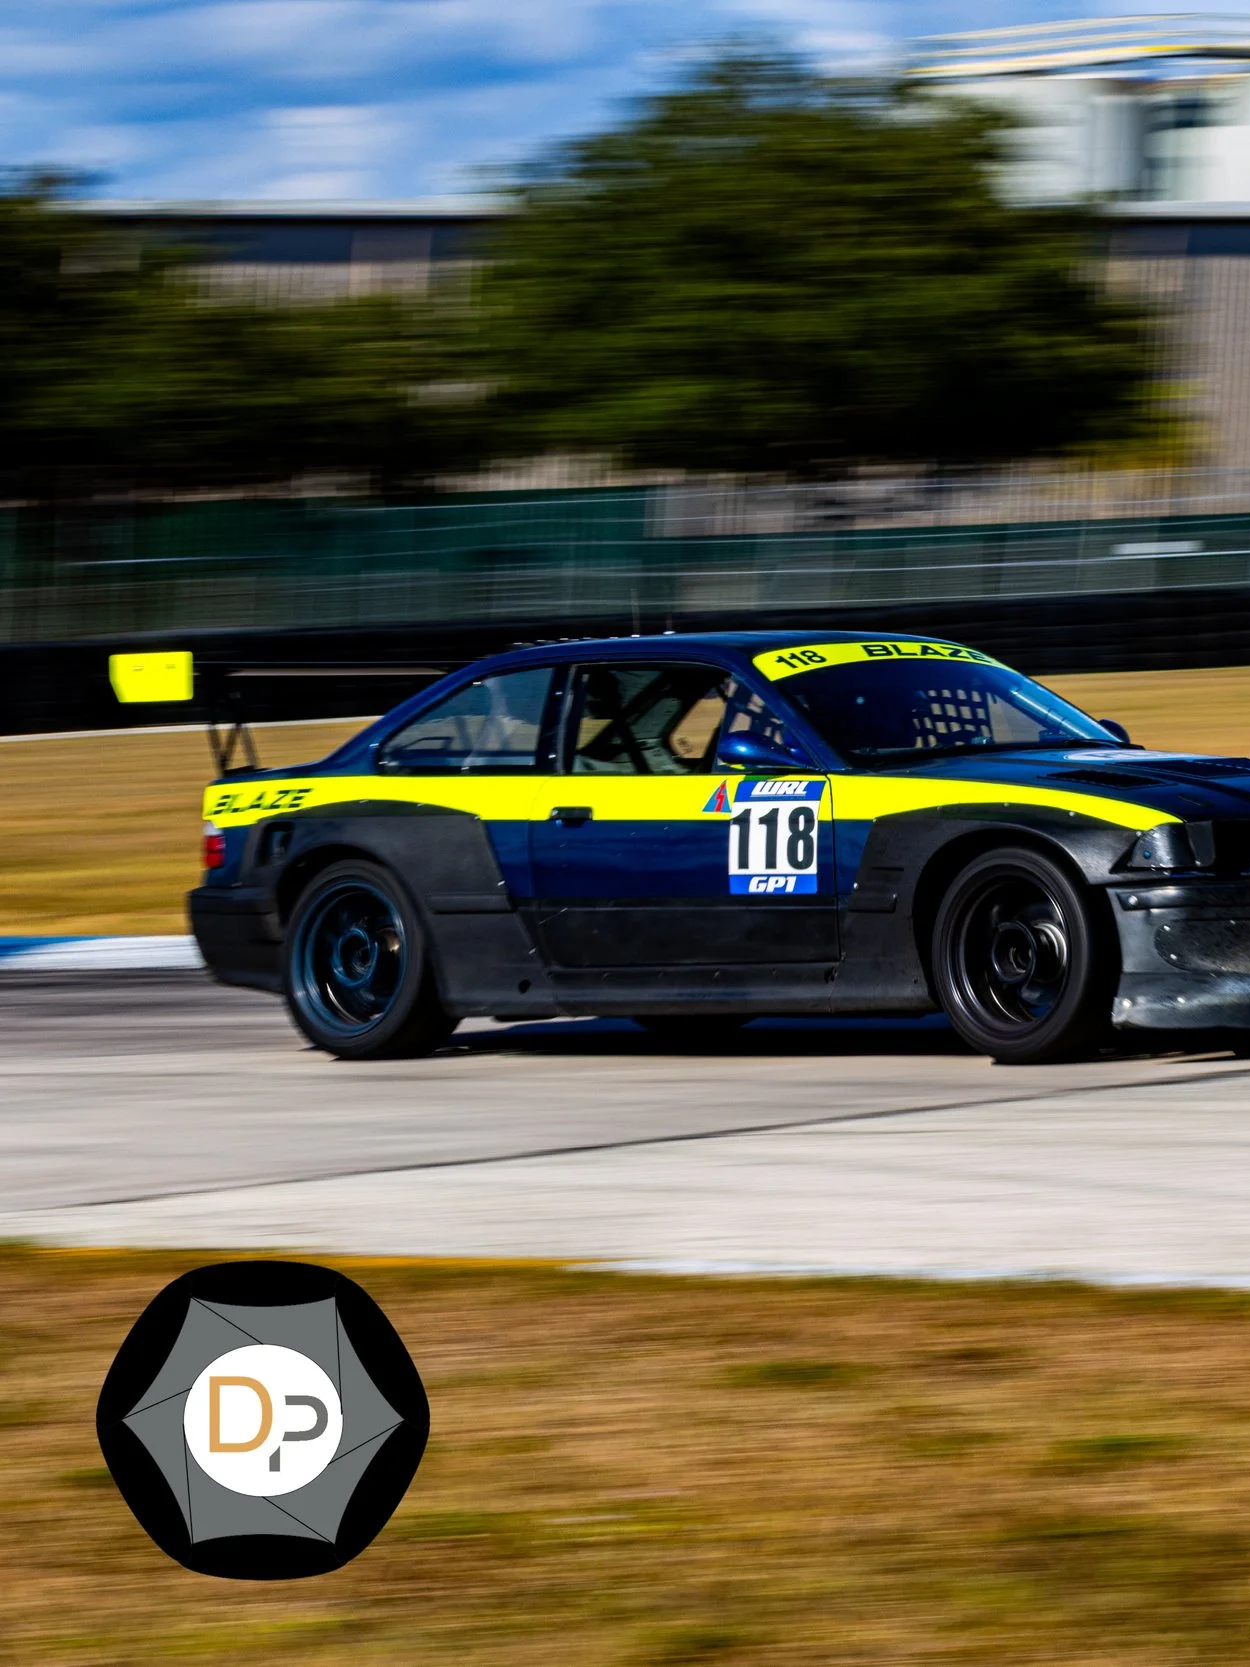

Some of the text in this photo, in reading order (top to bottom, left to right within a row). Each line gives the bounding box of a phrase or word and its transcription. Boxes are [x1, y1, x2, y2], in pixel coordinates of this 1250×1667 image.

[775, 643, 995, 669] 118 BLAZE
[209, 788, 313, 815] BLAZE
[750, 781, 809, 797] WRL
[730, 806, 815, 870] 118
[748, 876, 797, 893] GP1
